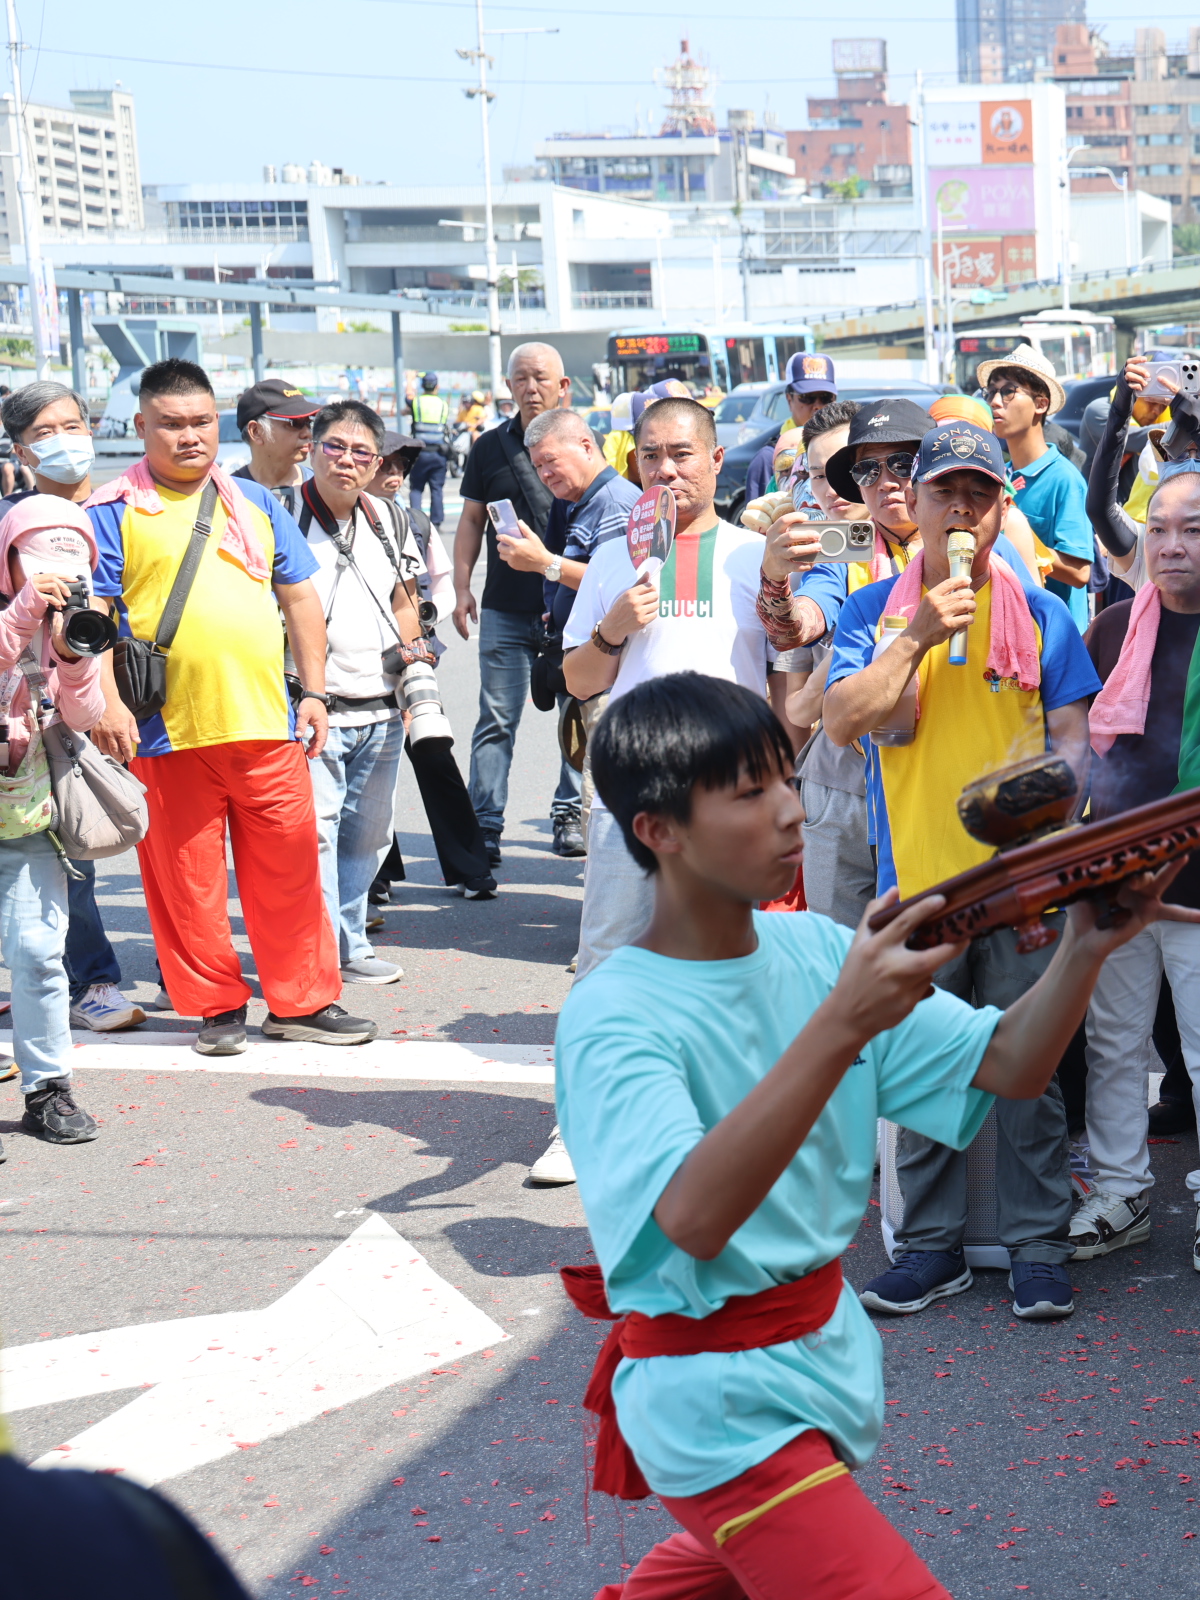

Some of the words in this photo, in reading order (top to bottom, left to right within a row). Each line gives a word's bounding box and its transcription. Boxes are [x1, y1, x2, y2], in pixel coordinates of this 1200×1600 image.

[980, 184, 1030, 199] POYA
[942, 243, 996, 281] すき家
[867, 414, 890, 426] Asahi
[932, 428, 992, 452] MONACO
[932, 451, 952, 463] MONTE
[973, 452, 993, 465] CARLO
[76, 540, 85, 548] CITY
[658, 599, 713, 618] GUCCI
